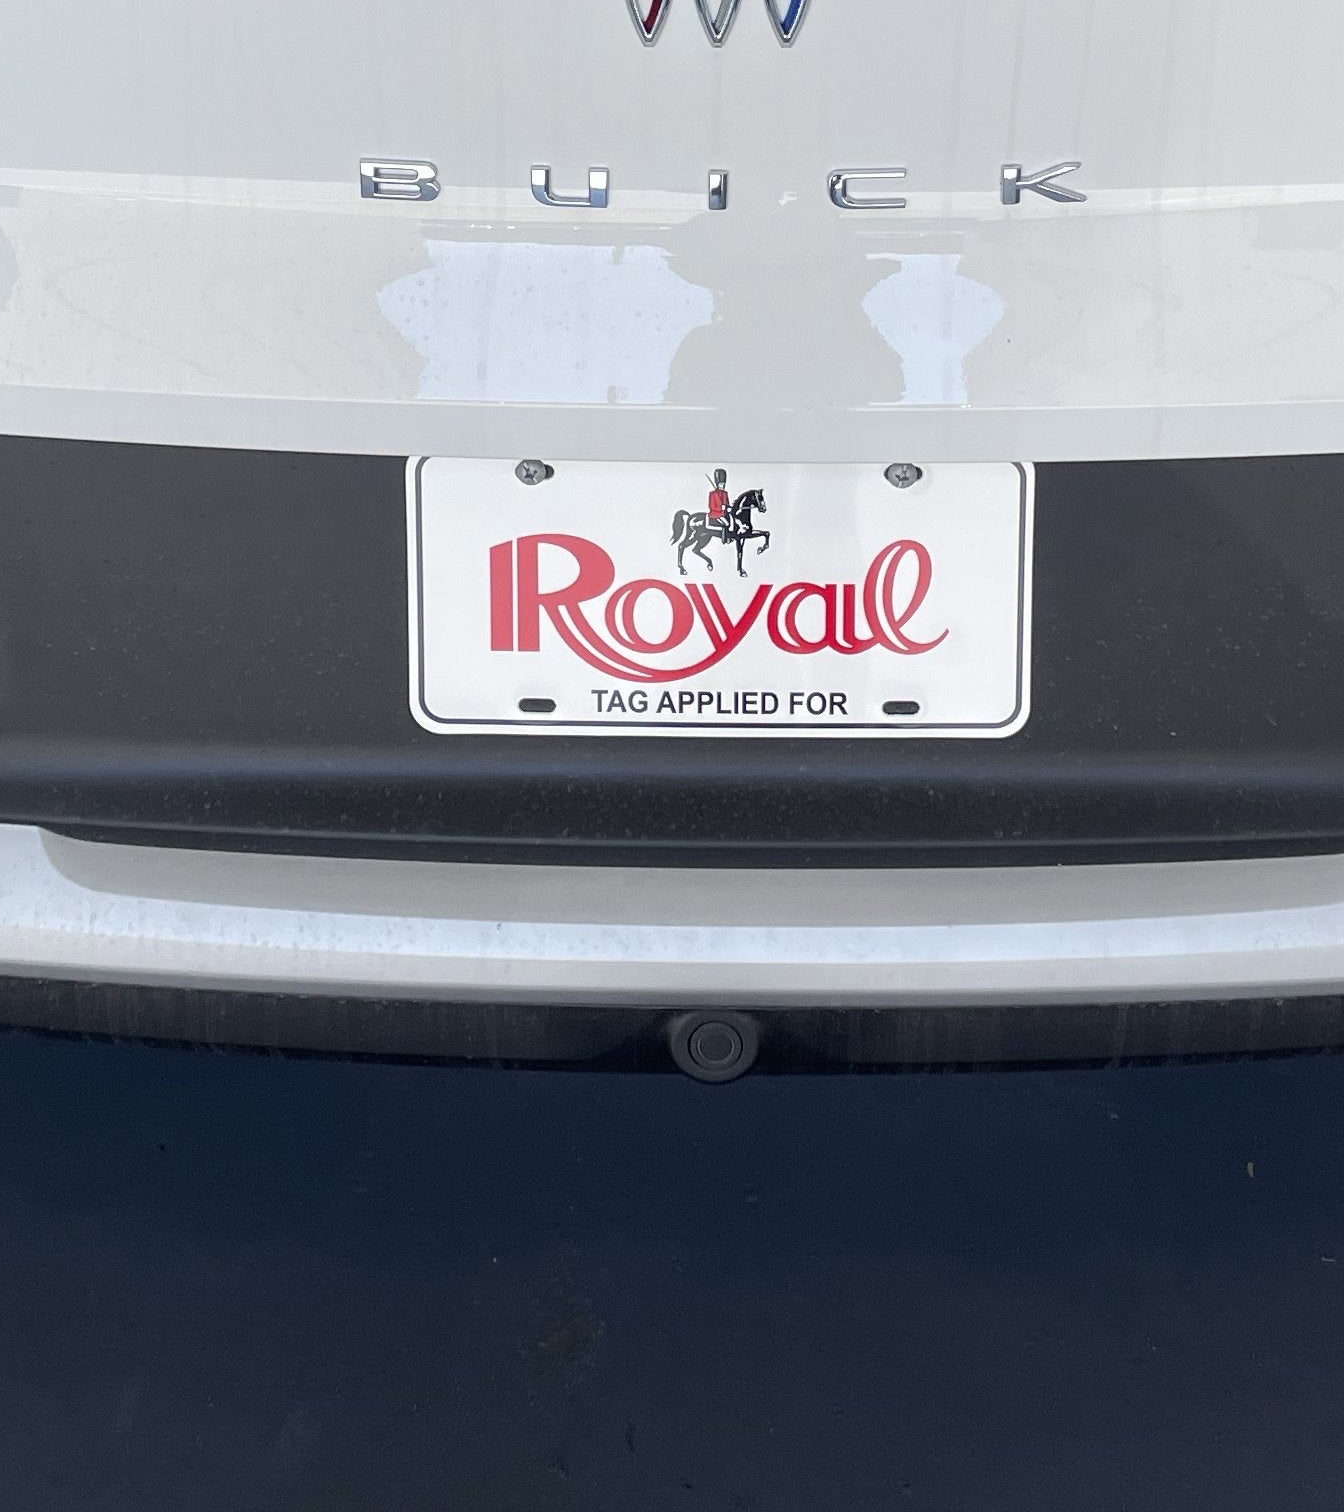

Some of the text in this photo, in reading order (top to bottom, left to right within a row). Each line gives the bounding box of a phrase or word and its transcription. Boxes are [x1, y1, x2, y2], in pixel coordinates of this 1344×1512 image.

[359, 157, 1088, 210] BUICK
[489, 533, 950, 684] Royal
[591, 689, 849, 716] TAG APPLIED FOR
